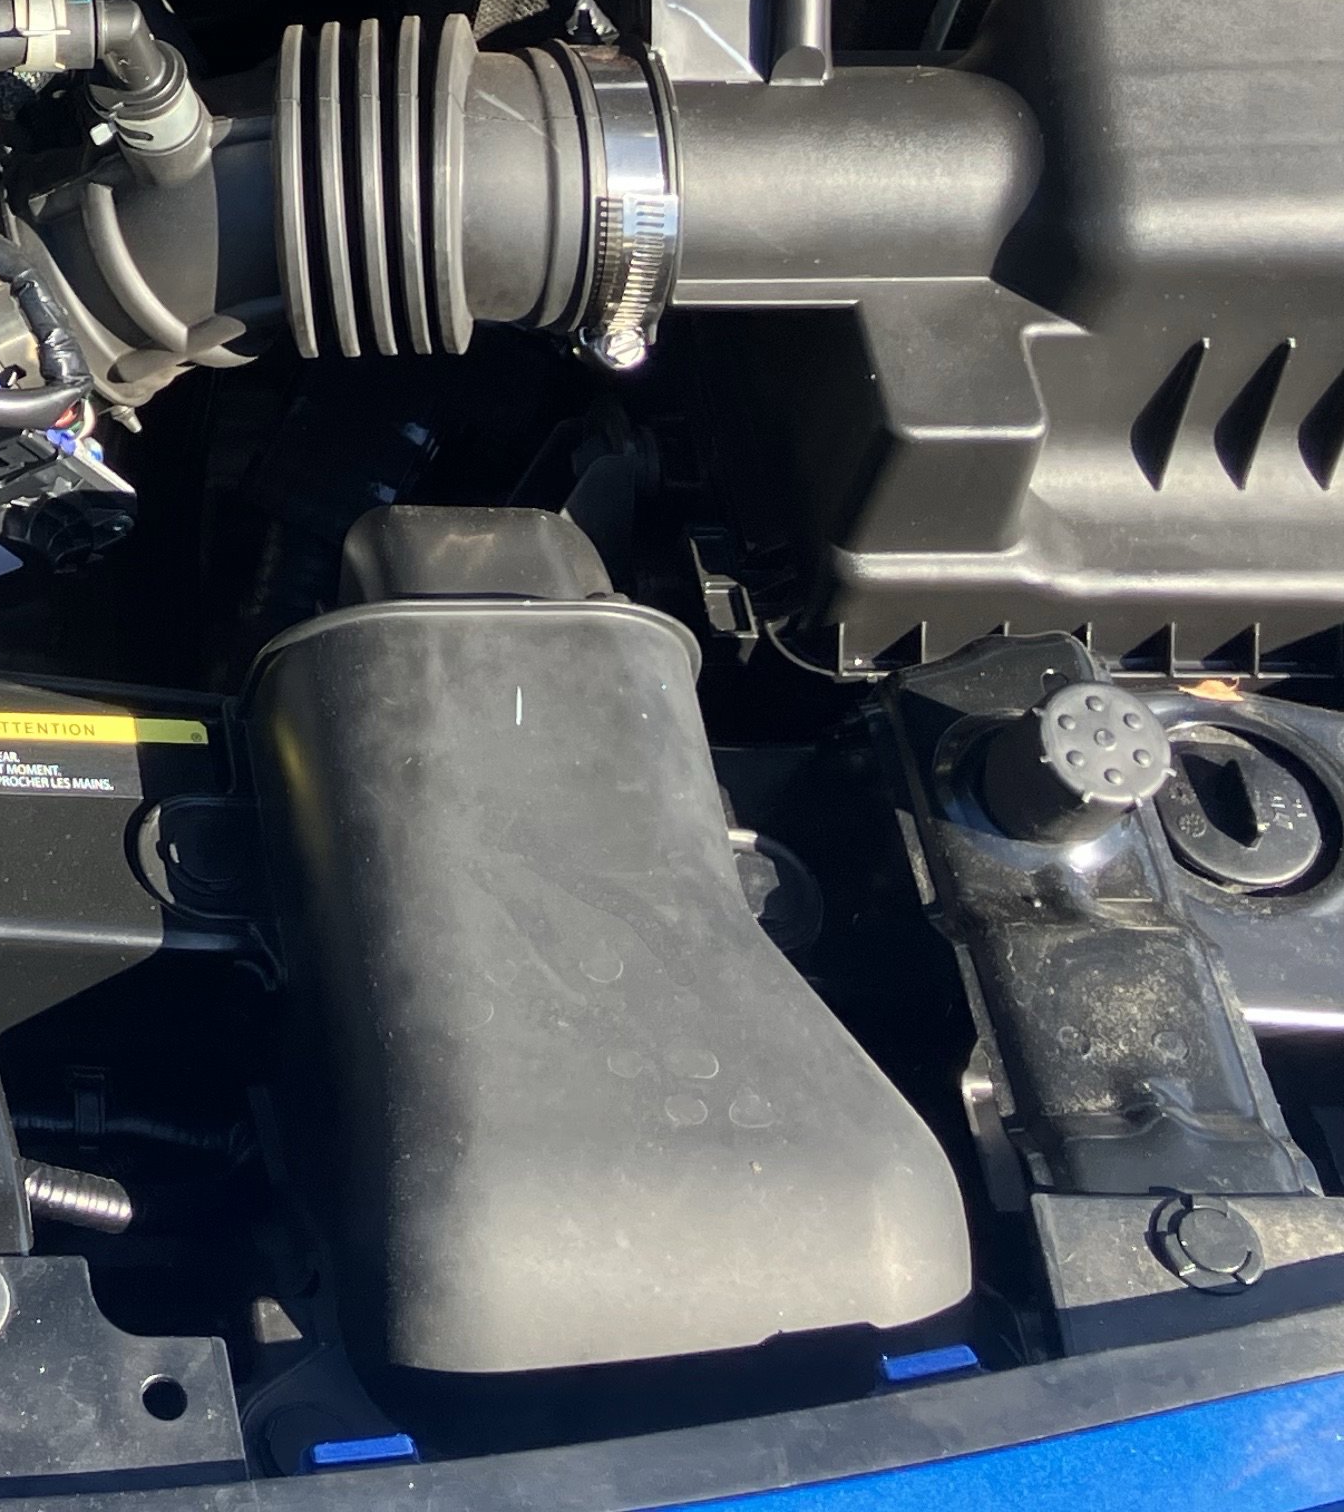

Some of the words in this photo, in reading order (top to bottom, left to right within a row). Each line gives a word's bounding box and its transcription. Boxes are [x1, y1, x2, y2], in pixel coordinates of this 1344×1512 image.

[6, 763, 62, 775] MOMENT.
[50, 776, 71, 789] LES
[72, 777, 114, 791] MAINS.
